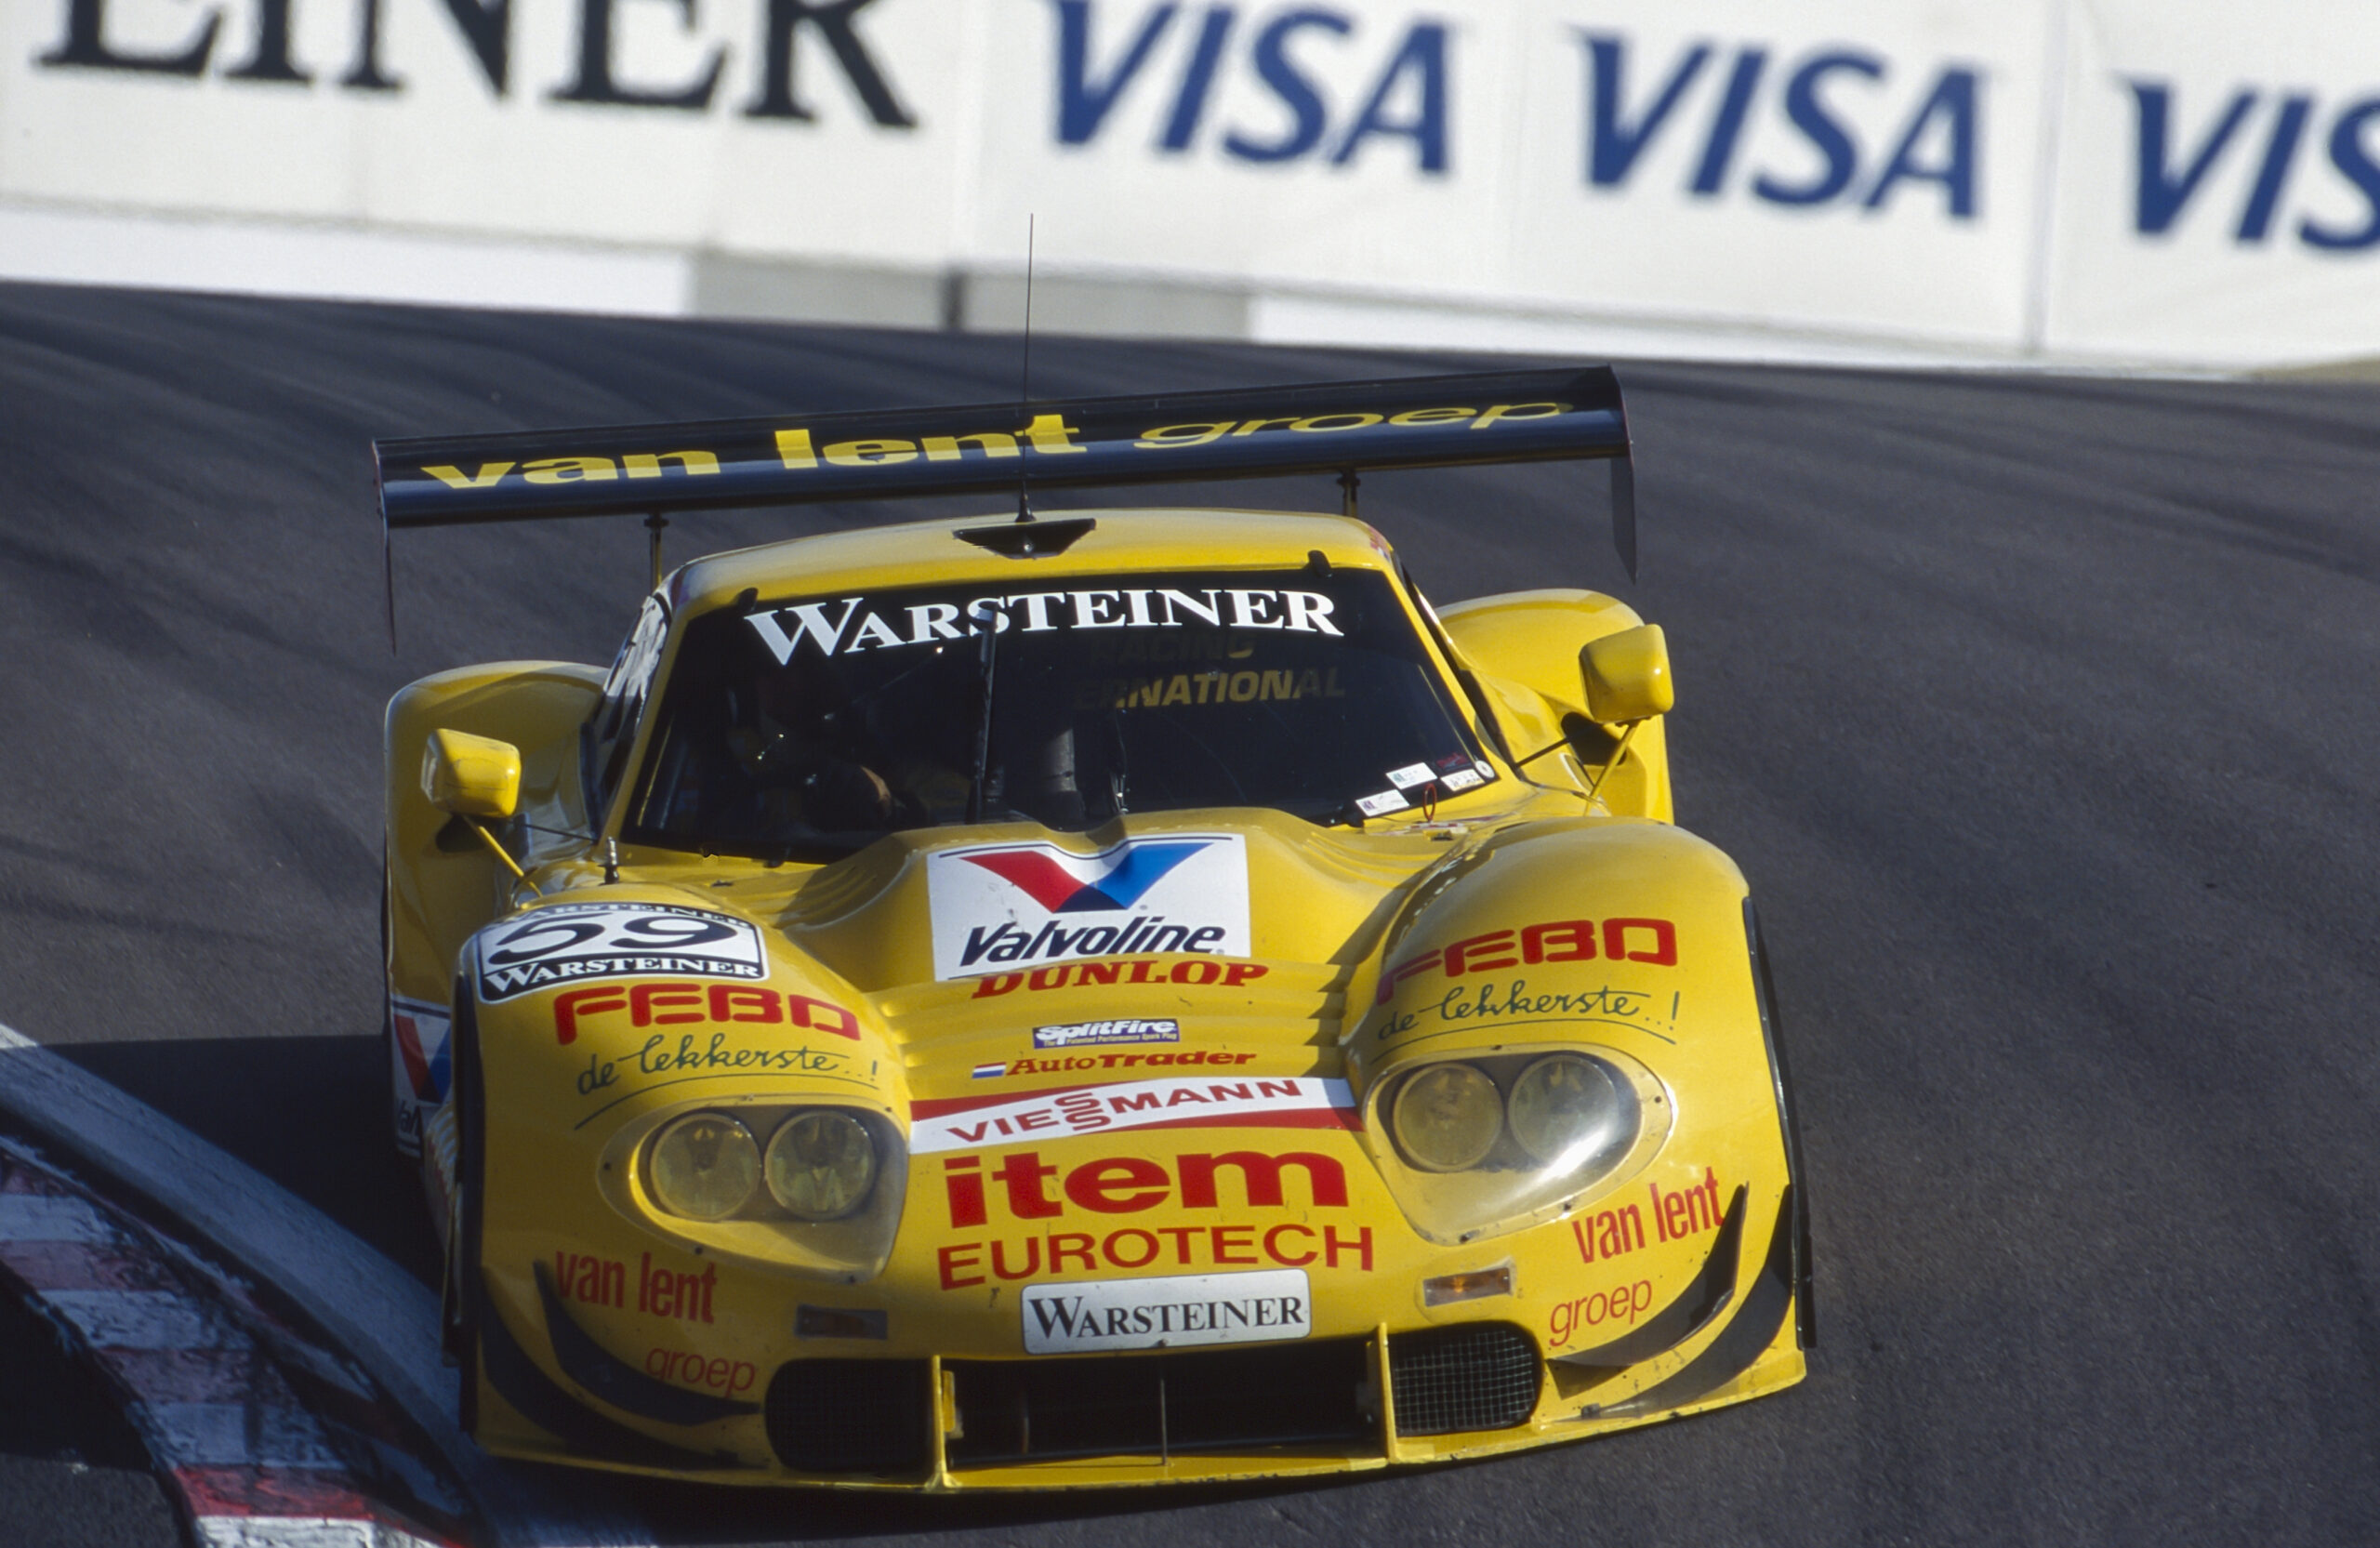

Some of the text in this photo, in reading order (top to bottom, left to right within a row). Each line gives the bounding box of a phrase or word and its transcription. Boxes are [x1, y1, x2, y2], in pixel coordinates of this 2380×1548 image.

[1047, 0, 1452, 179] VISA
[1575, 30, 1988, 219] VISA
[2122, 74, 2380, 253] VIS
[421, 402, 1573, 490] van lent groep
[745, 589, 1344, 666] WARSTEINER
[489, 912, 738, 965] 59
[521, 903, 751, 929] ARSTEINER
[959, 916, 1226, 967] Valvoline
[483, 957, 760, 992] WARSTEINER
[971, 959, 1269, 999] DUNLOP
[1036, 1020, 1177, 1046] SplitFire
[1378, 1011, 1420, 1040] de
[577, 1053, 620, 1096] de
[1006, 1051, 1257, 1076] AutoTrader
[946, 1079, 1302, 1143] VIESSMANN
[944, 1151, 1349, 1229] item
[1572, 1167, 1726, 1264] van lent
[937, 1224, 1373, 1291] EUROTECH
[556, 1251, 717, 1324] van lent
[1548, 1279, 1652, 1347] groep
[1028, 1296, 1305, 1339] WARSTEINER
[646, 1347, 756, 1396] groep
